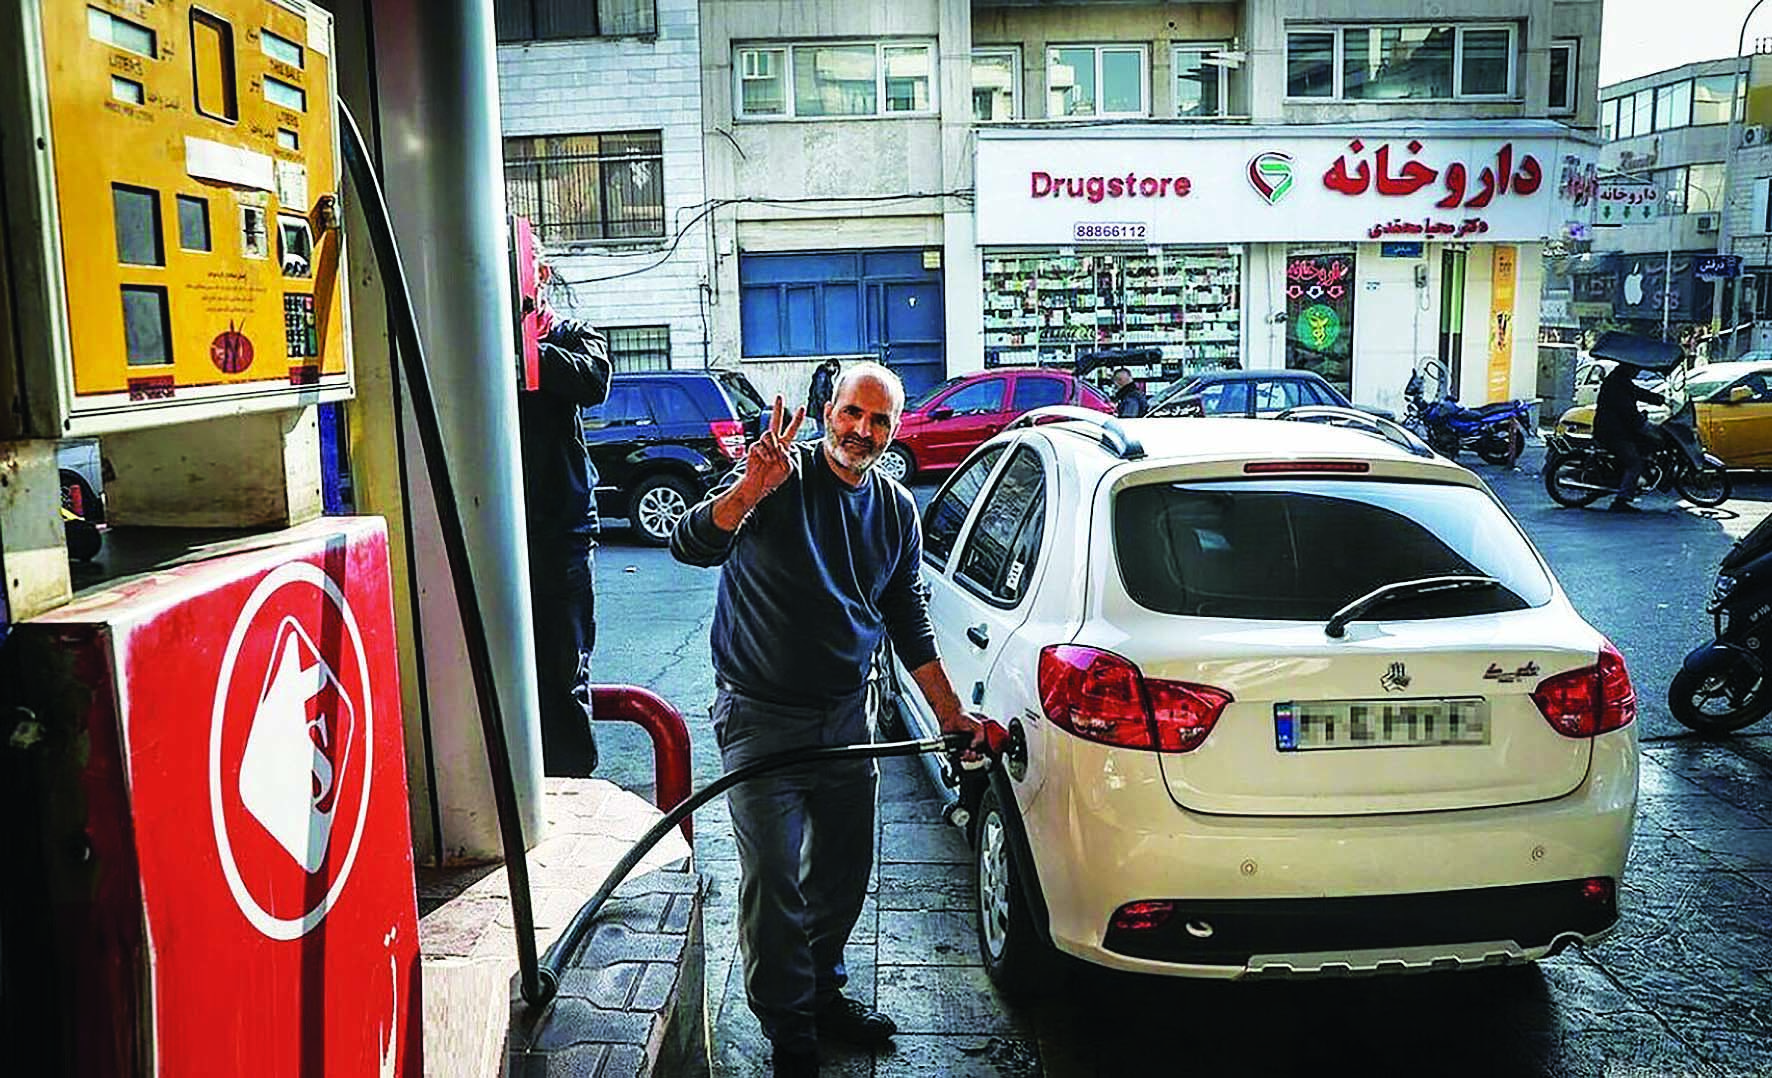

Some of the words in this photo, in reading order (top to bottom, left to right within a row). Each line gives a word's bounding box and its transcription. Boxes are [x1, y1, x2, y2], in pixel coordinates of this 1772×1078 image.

[1323, 138, 1543, 209] داروخانه
[1031, 171, 1192, 203] Drugstore
[1600, 188, 1657, 205] داروخانه
[1076, 225, 1146, 238] 88866112
